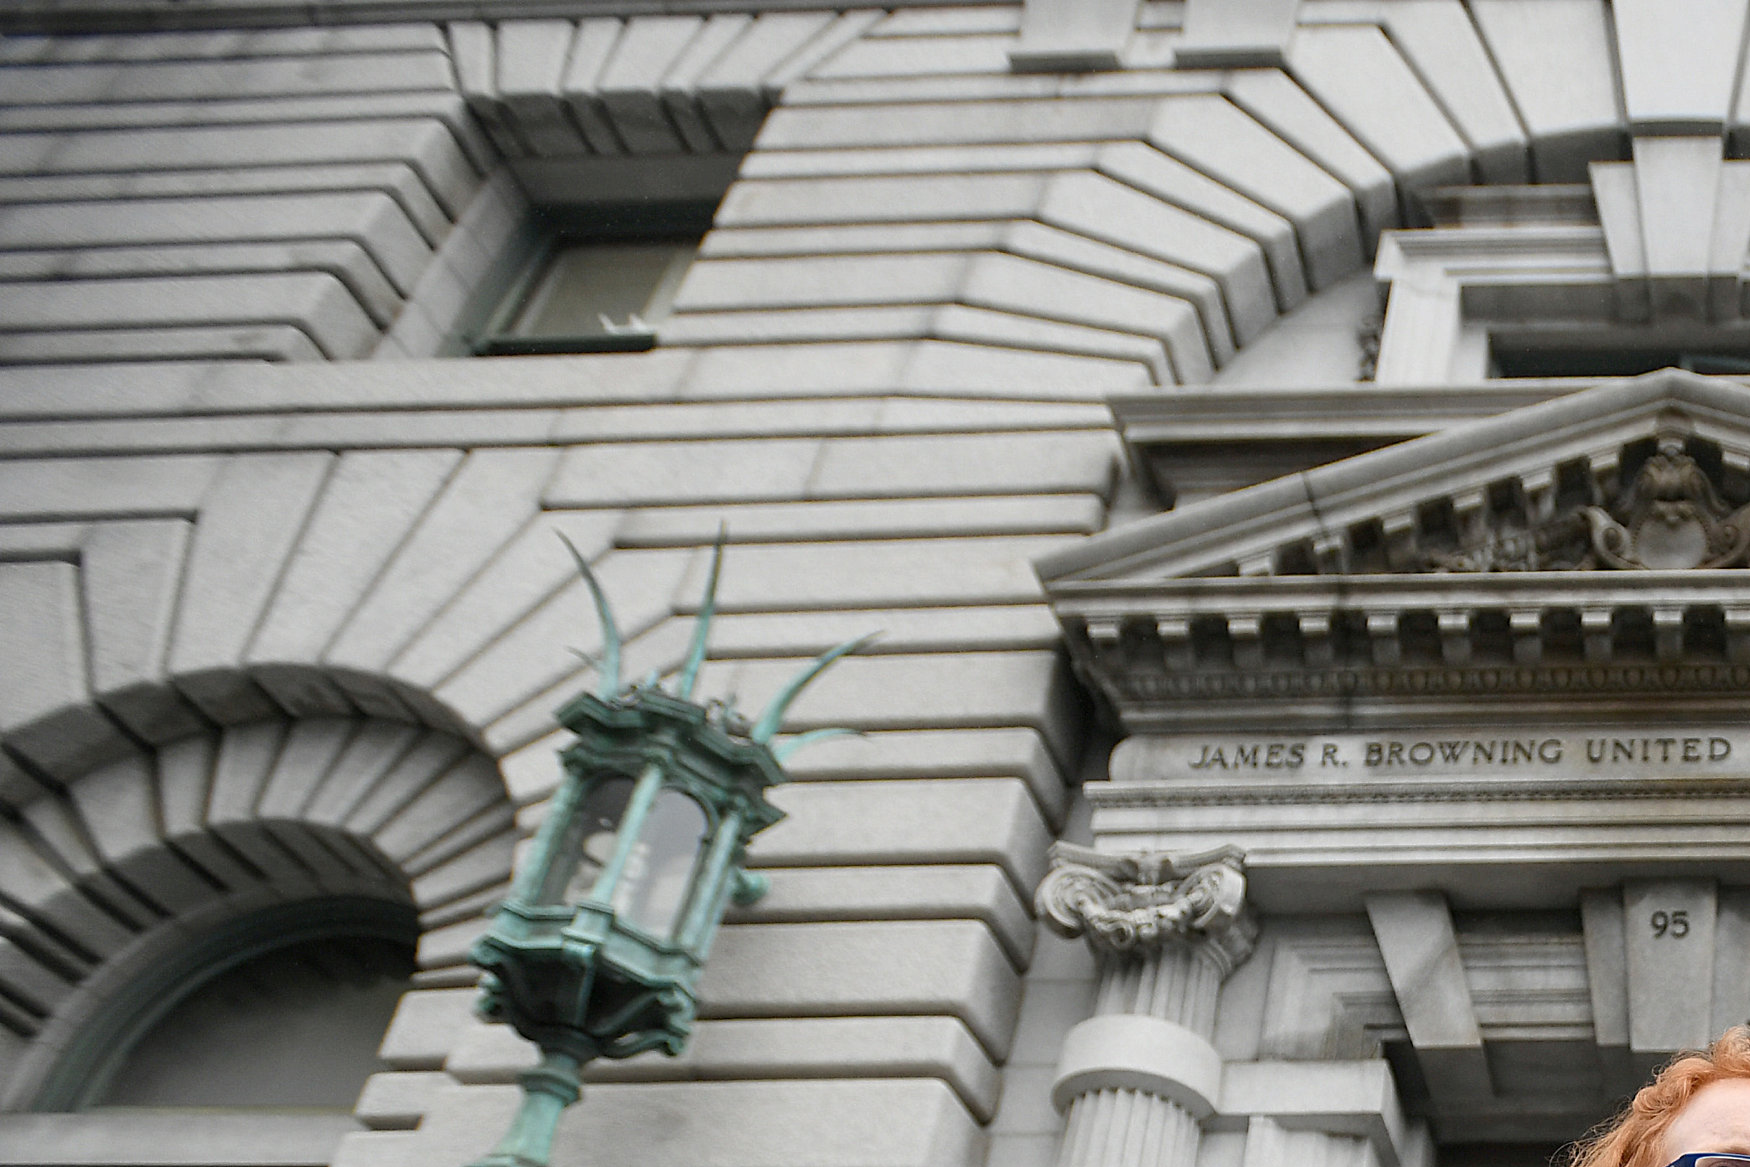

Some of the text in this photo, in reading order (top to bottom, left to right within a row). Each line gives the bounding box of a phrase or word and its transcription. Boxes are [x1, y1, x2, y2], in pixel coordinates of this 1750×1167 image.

[1189, 742, 1304, 770] JAMES
[1320, 743, 1348, 767] R.
[1365, 738, 1564, 768] BROWNING
[1586, 736, 1732, 763] UNITED
[1651, 910, 1689, 939] 95
